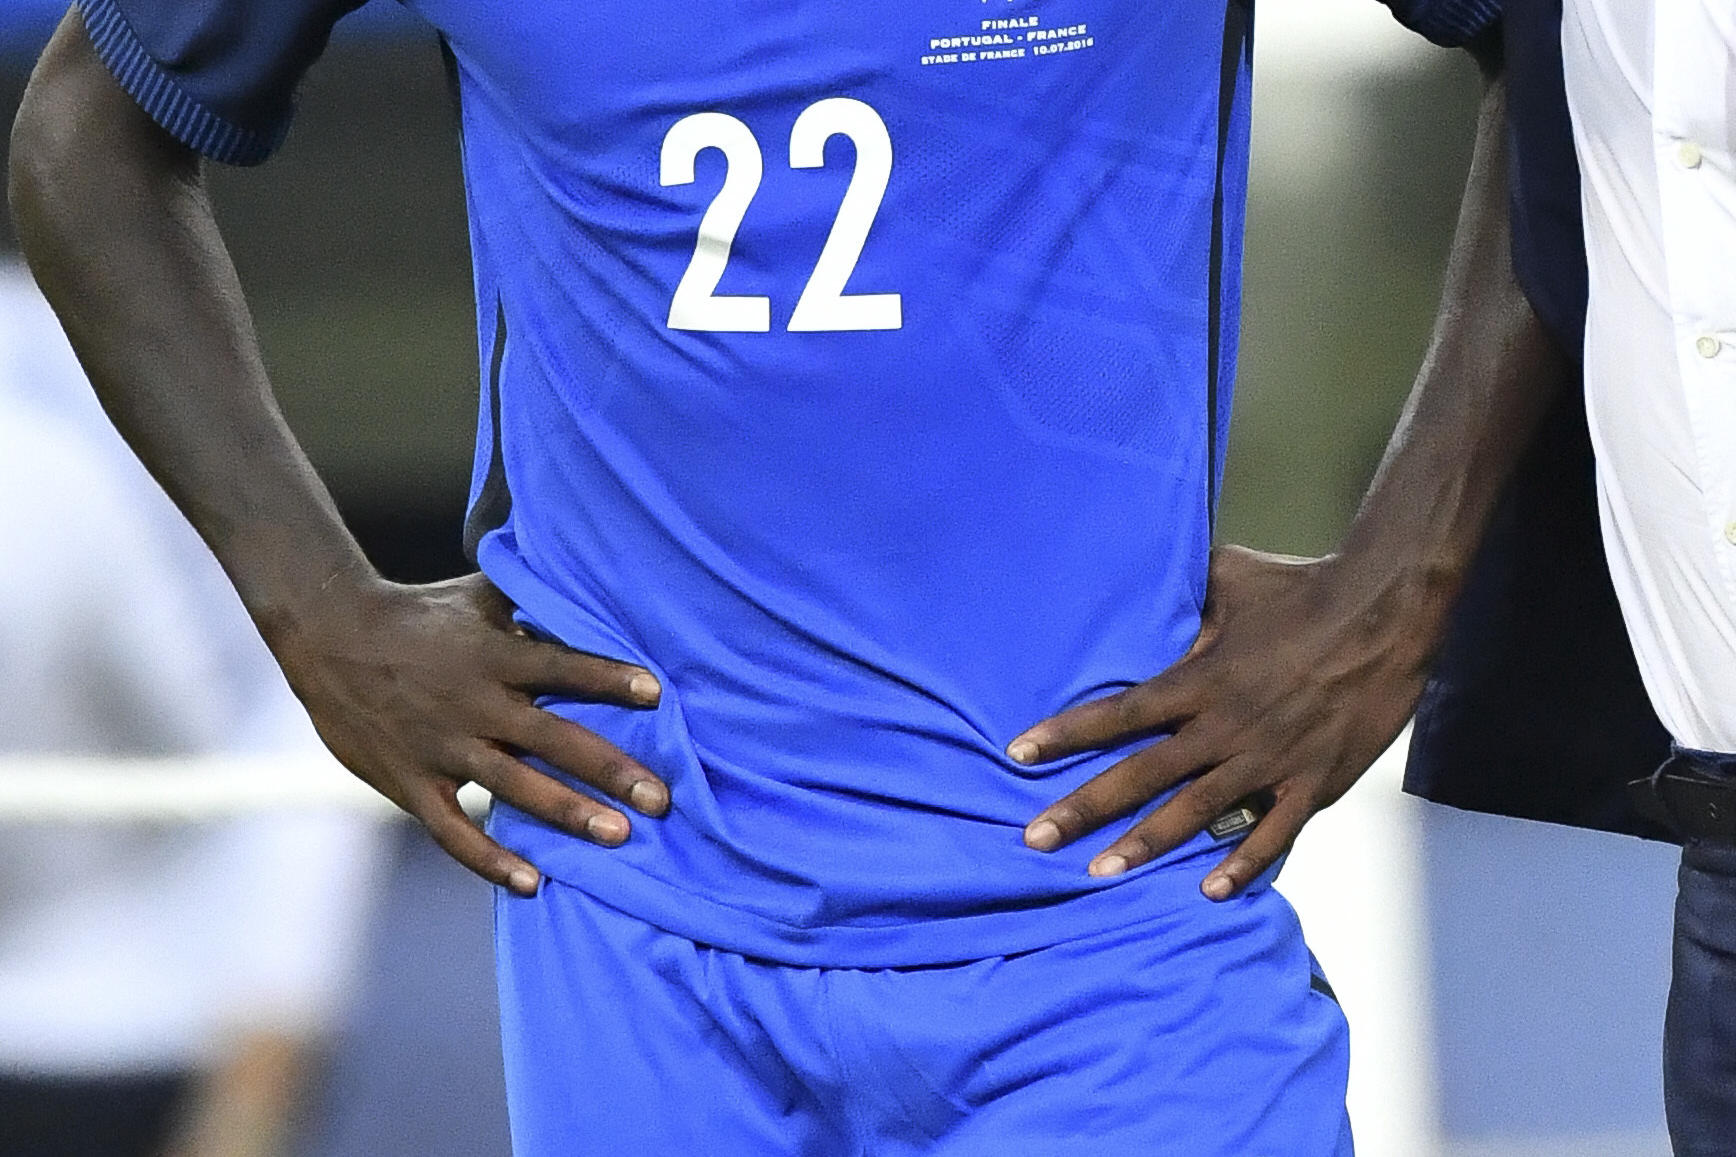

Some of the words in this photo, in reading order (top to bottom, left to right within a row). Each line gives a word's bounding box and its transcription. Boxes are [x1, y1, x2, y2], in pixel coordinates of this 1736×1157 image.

[981, 16, 1039, 30] FINALE
[930, 35, 1014, 50] PORTUGAL
[1027, 24, 1087, 42] FRANCE
[920, 54, 959, 65] STADE
[961, 52, 977, 62] DE
[980, 48, 1026, 60] FRANCE
[660, 97, 902, 332] 22
